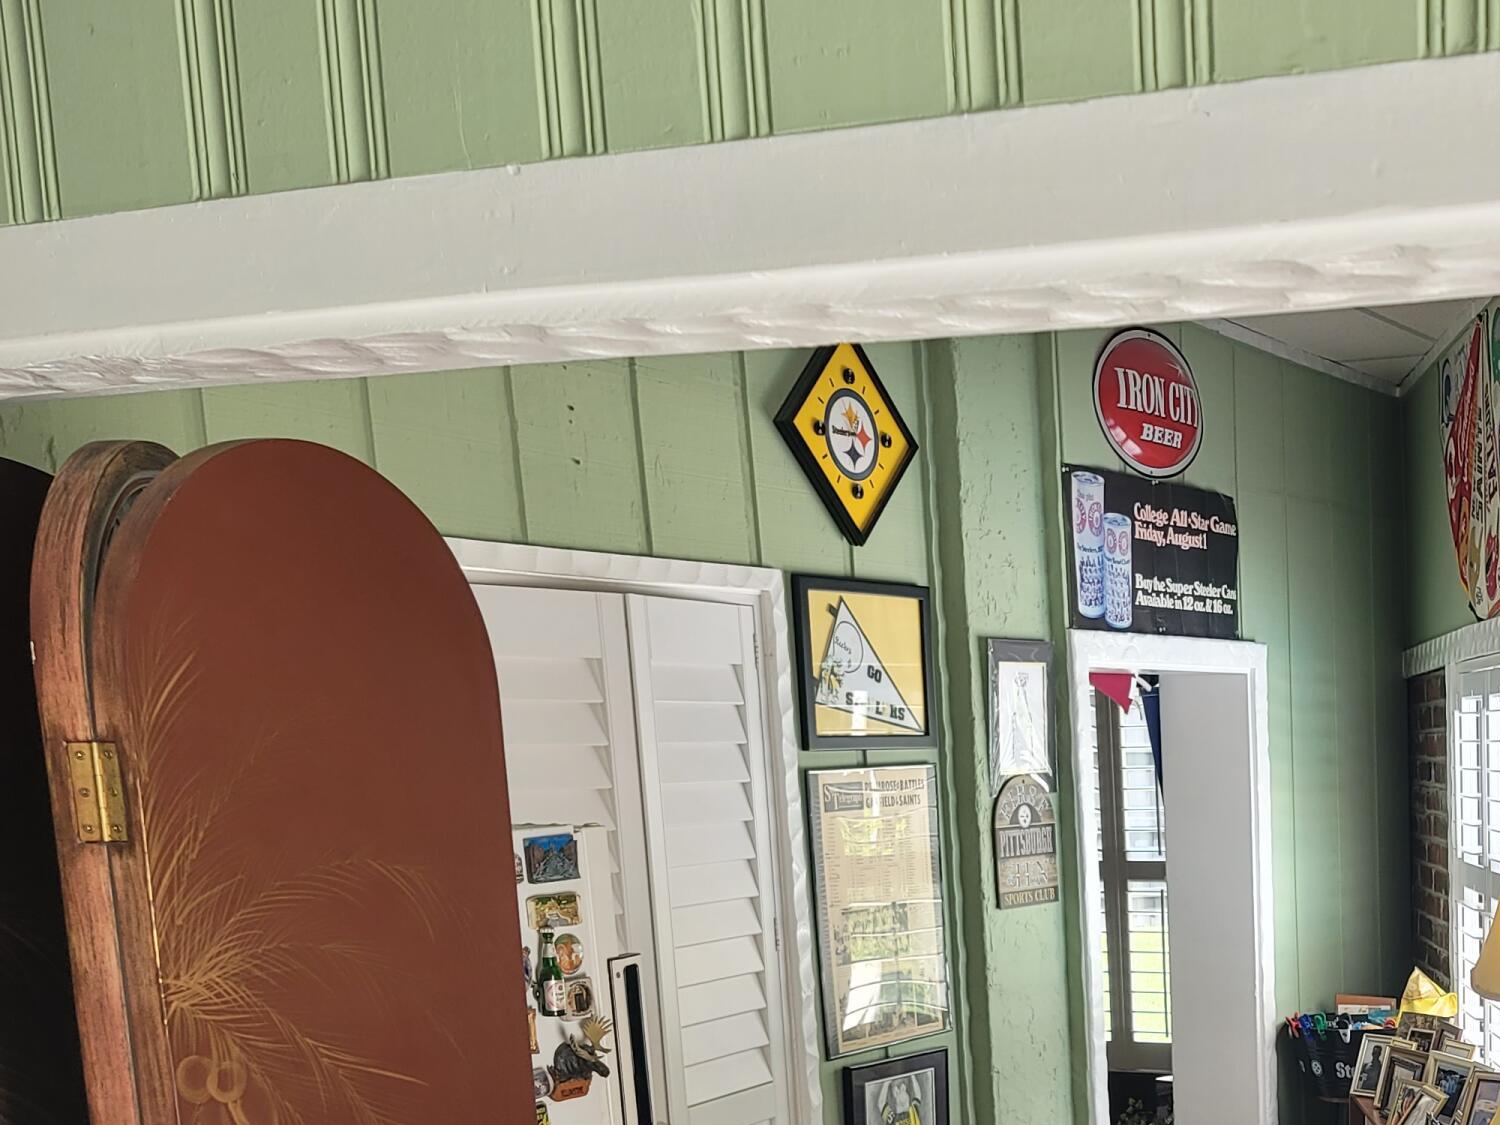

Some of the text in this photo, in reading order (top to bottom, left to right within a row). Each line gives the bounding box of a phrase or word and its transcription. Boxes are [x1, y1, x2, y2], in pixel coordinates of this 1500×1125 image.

[1114, 367, 1166, 418] IRON
[1140, 423, 1183, 449] BEER
[1133, 502, 1169, 527] College
[1210, 516, 1237, 537] Game
[1134, 521, 1166, 547] Friday,
[1167, 527, 1203, 551] August
[1135, 573, 1152, 593] Buy
[1166, 578, 1193, 597] Super
[1194, 581, 1222, 599] Steeler
[1135, 590, 1174, 609] Available
[1182, 597, 1193, 611] 12
[867, 664, 883, 684] GO
[1000, 826, 1054, 858] PITTSBURGH
[1004, 887, 1056, 906] SPORTS CLUB
